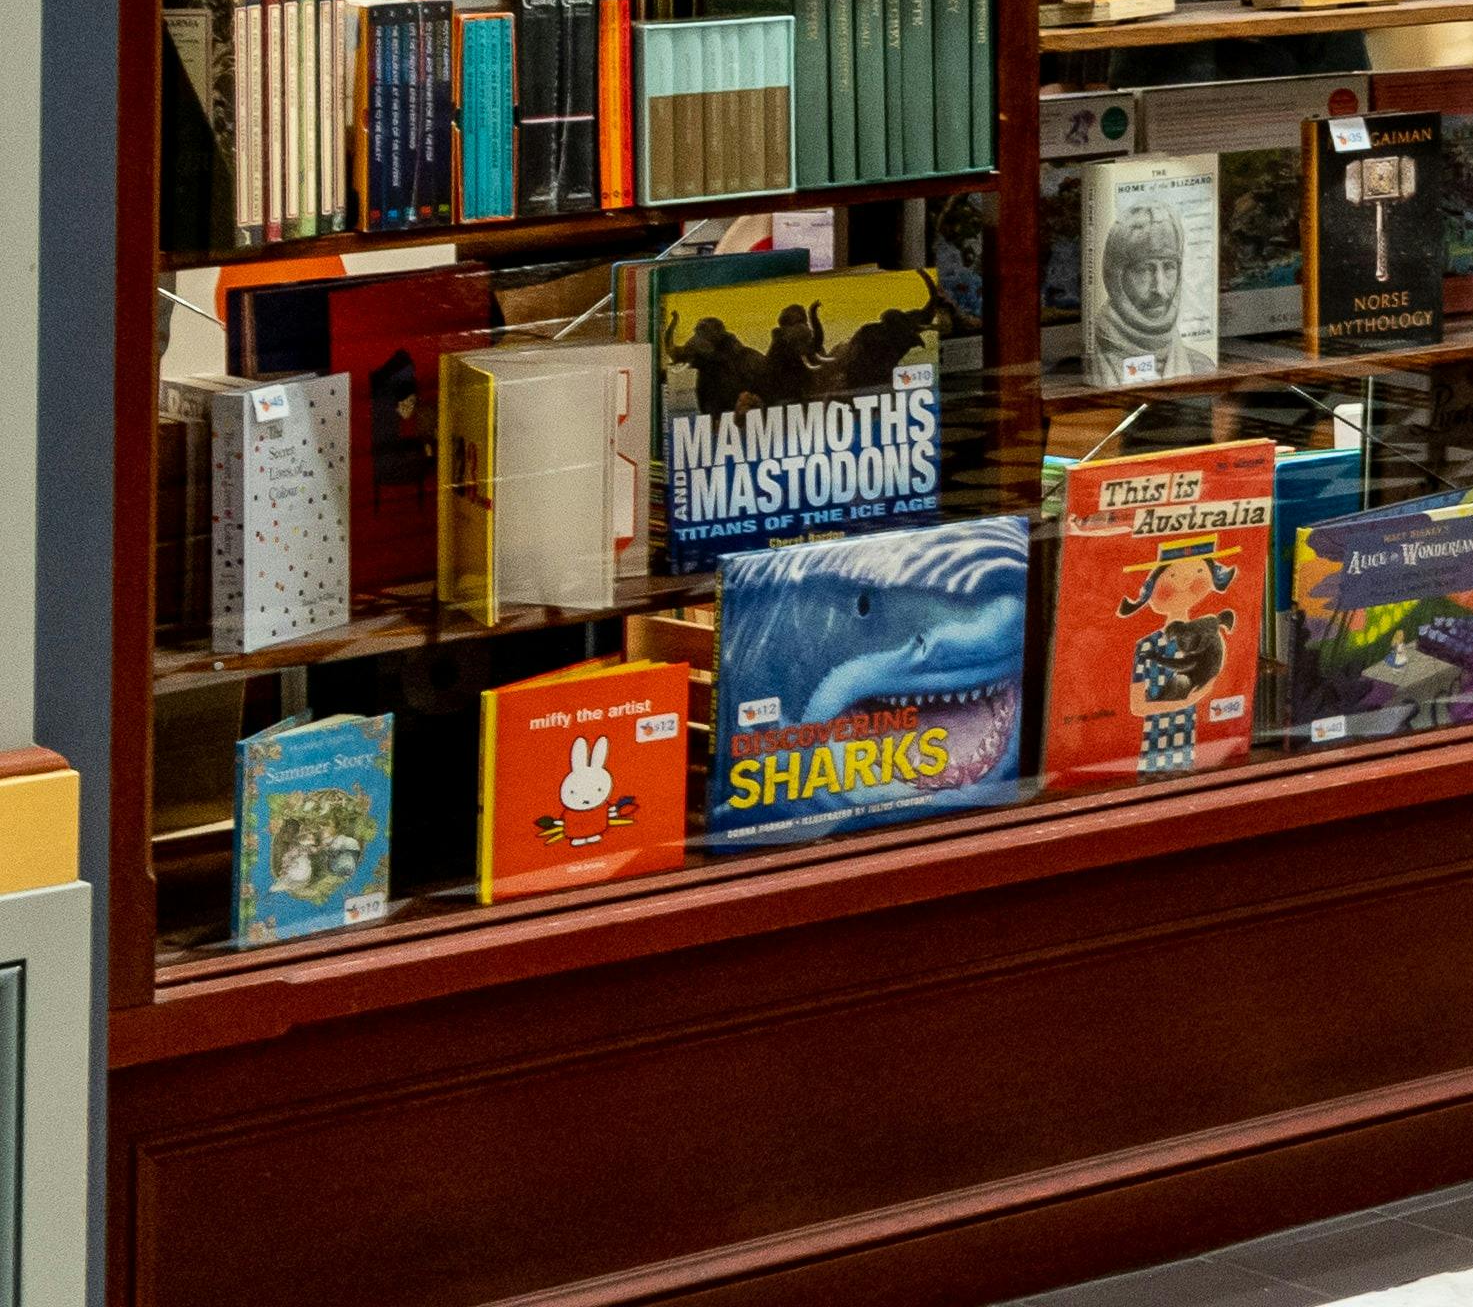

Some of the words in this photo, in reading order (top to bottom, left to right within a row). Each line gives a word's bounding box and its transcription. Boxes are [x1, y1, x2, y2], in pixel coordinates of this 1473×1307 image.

[1370, 126, 1433, 147] GAIMAN
[1117, 183, 1145, 194] HOME
[1170, 176, 1212, 188] BLIZZARD
[1353, 290, 1410, 312] NORSE
[1328, 310, 1434, 338] MYTHOLOGY
[672, 388, 937, 471] MAMMOTHS
[673, 468, 690, 521] AND
[690, 438, 937, 523] MASTODONS
[1104, 479, 1167, 508] This
[1173, 473, 1200, 499] is
[674, 519, 758, 544] TITANS
[764, 513, 795, 532] OF
[800, 506, 844, 527] THE
[850, 501, 886, 520] ICE
[892, 495, 938, 514] AGE
[1133, 501, 1267, 536] Australia
[529, 711, 572, 734] miffy
[576, 705, 604, 722] the
[607, 697, 653, 719] artist
[730, 705, 920, 759] DISCOVERING
[264, 757, 329, 785] Summer
[331, 749, 375, 776] Story
[728, 727, 950, 811] SHARKS
